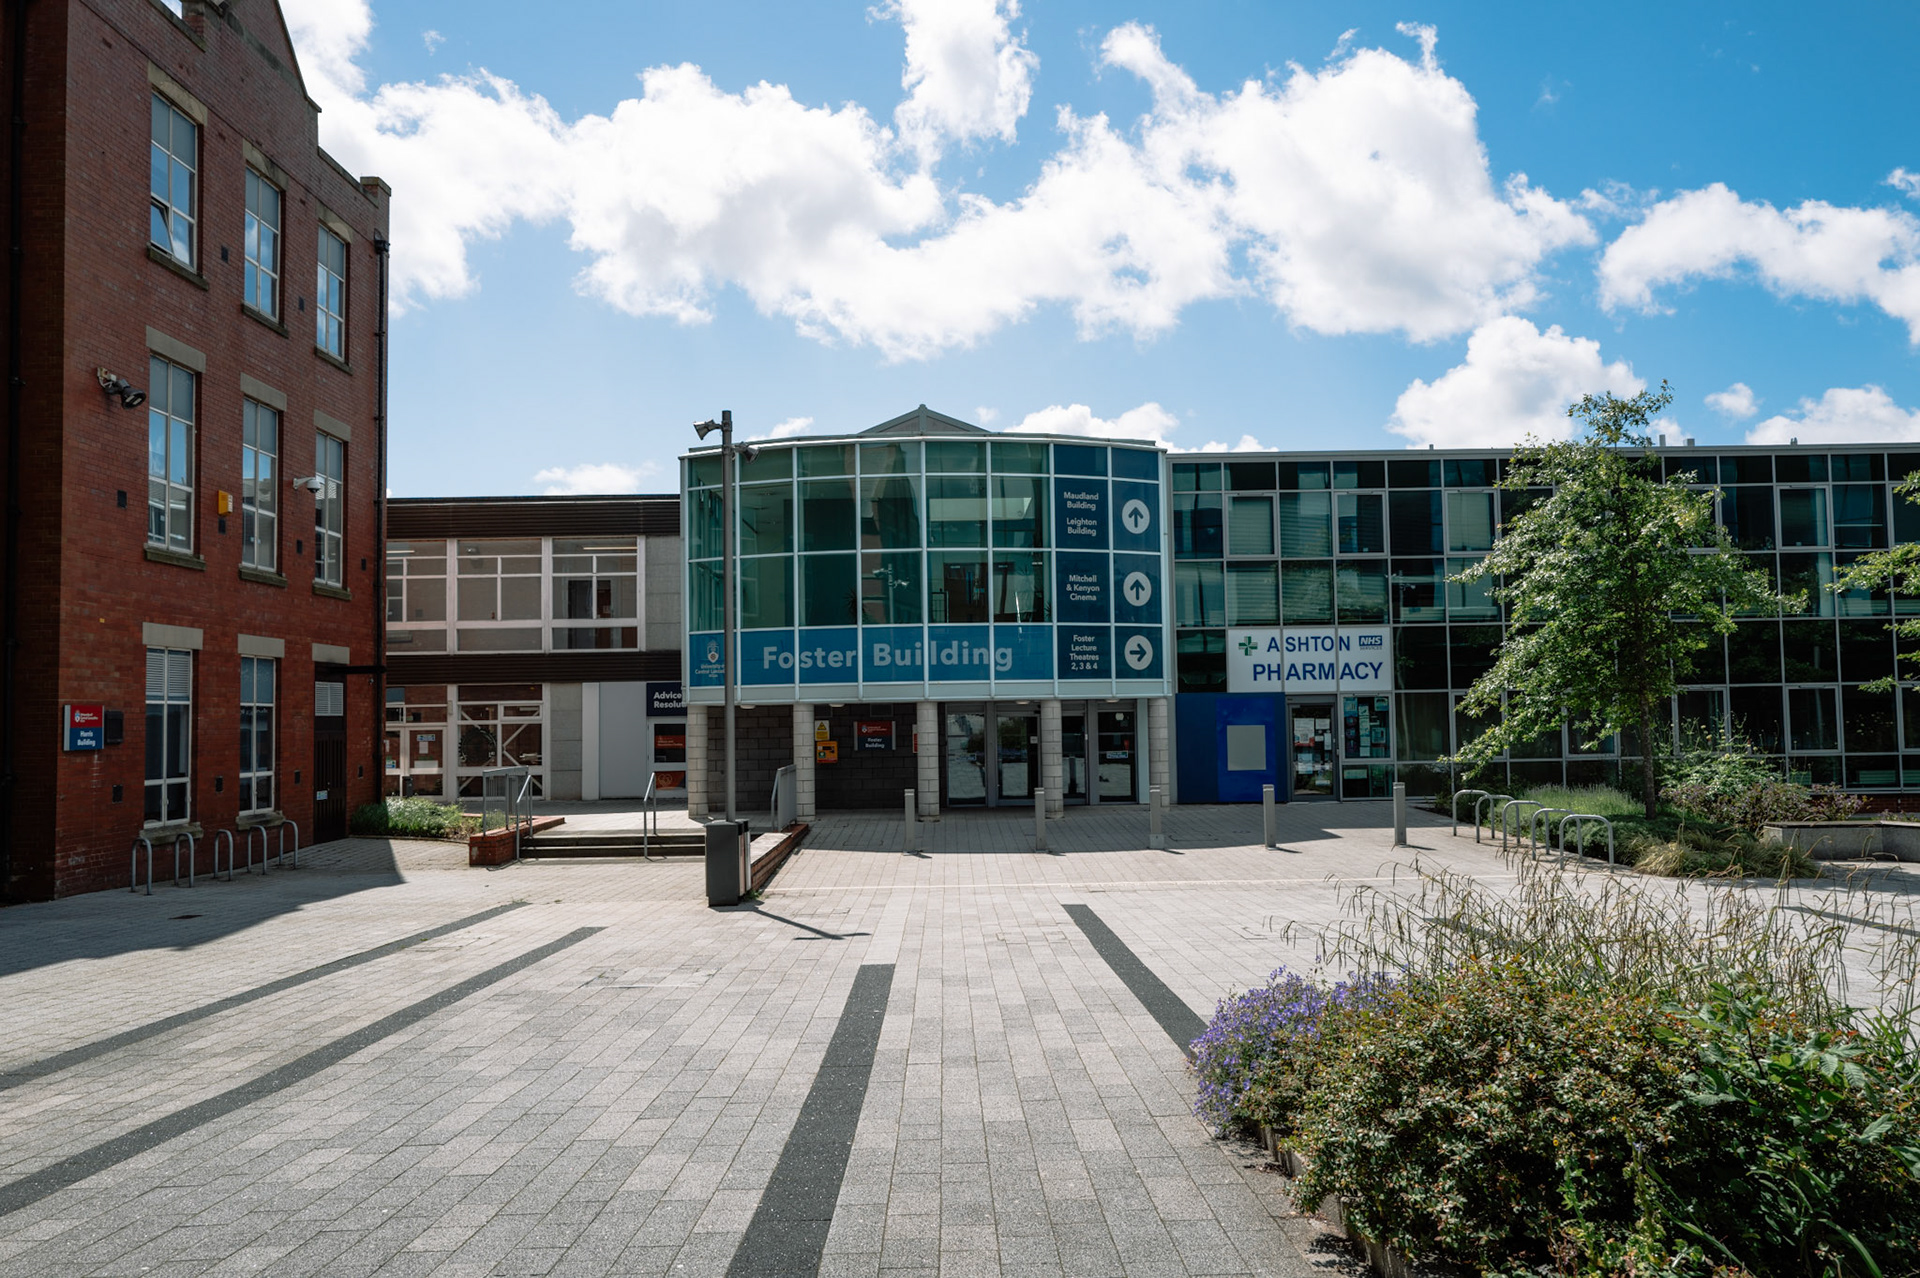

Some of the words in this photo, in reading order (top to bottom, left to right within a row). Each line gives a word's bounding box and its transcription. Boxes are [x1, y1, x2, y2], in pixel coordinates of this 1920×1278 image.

[1063, 491, 1099, 500] Maudland
[1066, 501, 1096, 511] Building
[1066, 517, 1097, 527] Leighton
[1067, 527, 1097, 537] Building
[1069, 574, 1097, 583] Mitchell
[1066, 584, 1072, 592] &
[1073, 584, 1100, 593] Kenyon
[1069, 593, 1097, 601] Cinema
[1073, 634, 1095, 642] Foster
[1360, 636, 1382, 645] NHS
[1266, 636, 1350, 652] ASHTON
[763, 646, 857, 669] Foster
[873, 640, 1013, 672] Building
[1071, 662, 1078, 671] 2,
[1079, 662, 1084, 670] 3
[1085, 662, 1092, 670] &
[1092, 662, 1098, 670] 4
[1252, 661, 1383, 681] PHARMACY
[653, 691, 683, 700] Advice
